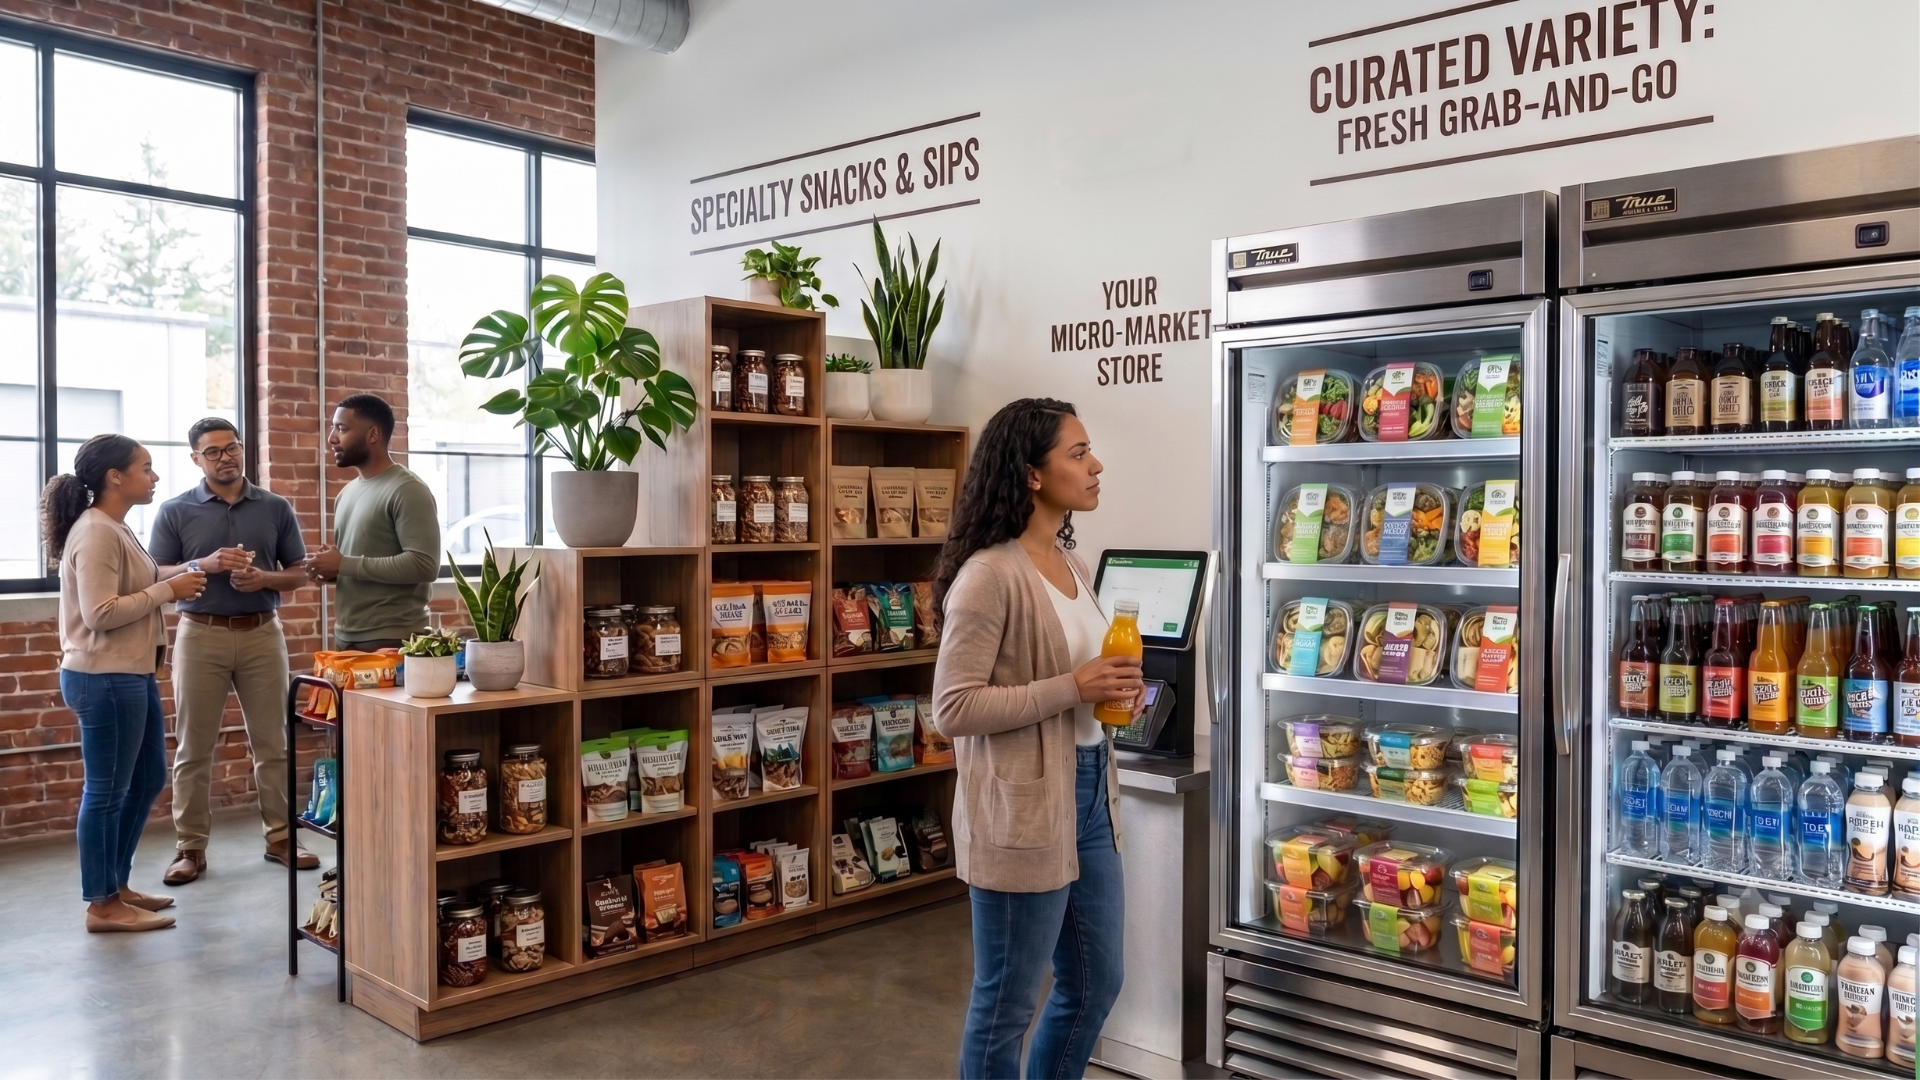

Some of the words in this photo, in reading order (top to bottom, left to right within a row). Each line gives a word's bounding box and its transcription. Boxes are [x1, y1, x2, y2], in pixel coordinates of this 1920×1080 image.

[1310, 33, 1490, 114] CURATED
[1505, 0, 1714, 76] VARIETY:
[1338, 105, 1428, 155] FRESH
[1440, 60, 1677, 137] GRAB-AND-GO
[691, 178, 794, 235] SPECIALTY
[799, 157, 887, 214] SNACKS
[895, 152, 916, 195] &
[923, 136, 980, 190] SIPS
[1616, 194, 1672, 209] True
[1250, 248, 1293, 261] True
[1102, 276, 1157, 310] YOUR
[1051, 309, 1211, 353] MICRO-MARKET
[1097, 353, 1163, 386] STORE
